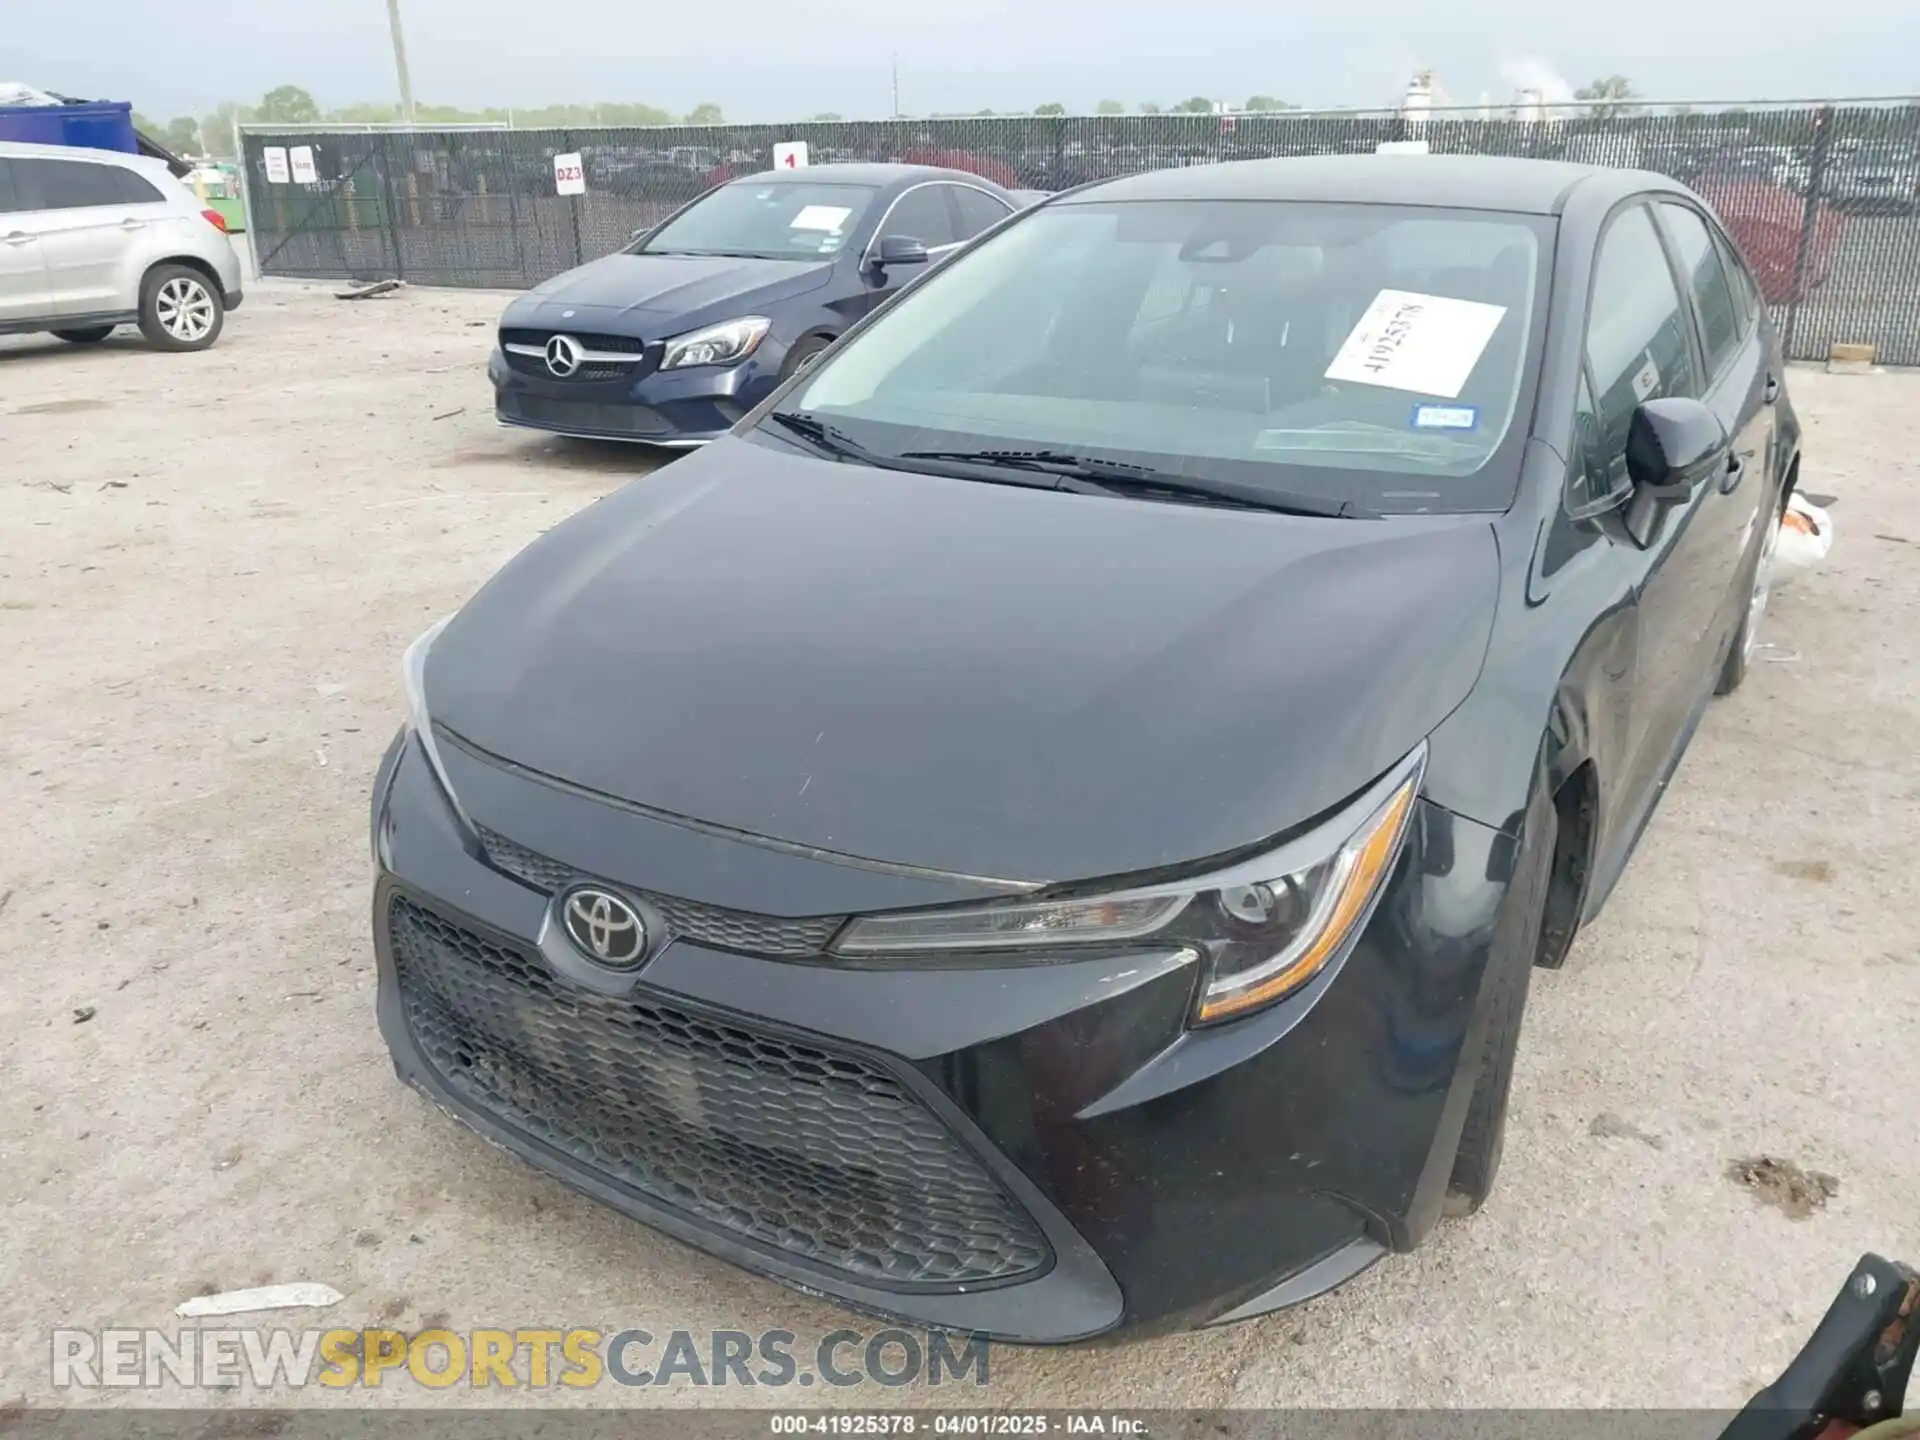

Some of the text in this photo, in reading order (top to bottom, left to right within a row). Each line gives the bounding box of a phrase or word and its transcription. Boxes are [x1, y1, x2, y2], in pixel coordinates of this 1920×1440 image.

[784, 153, 795, 169] 1
[557, 167, 581, 181] DZ3
[1363, 304, 1424, 373] 41925378
